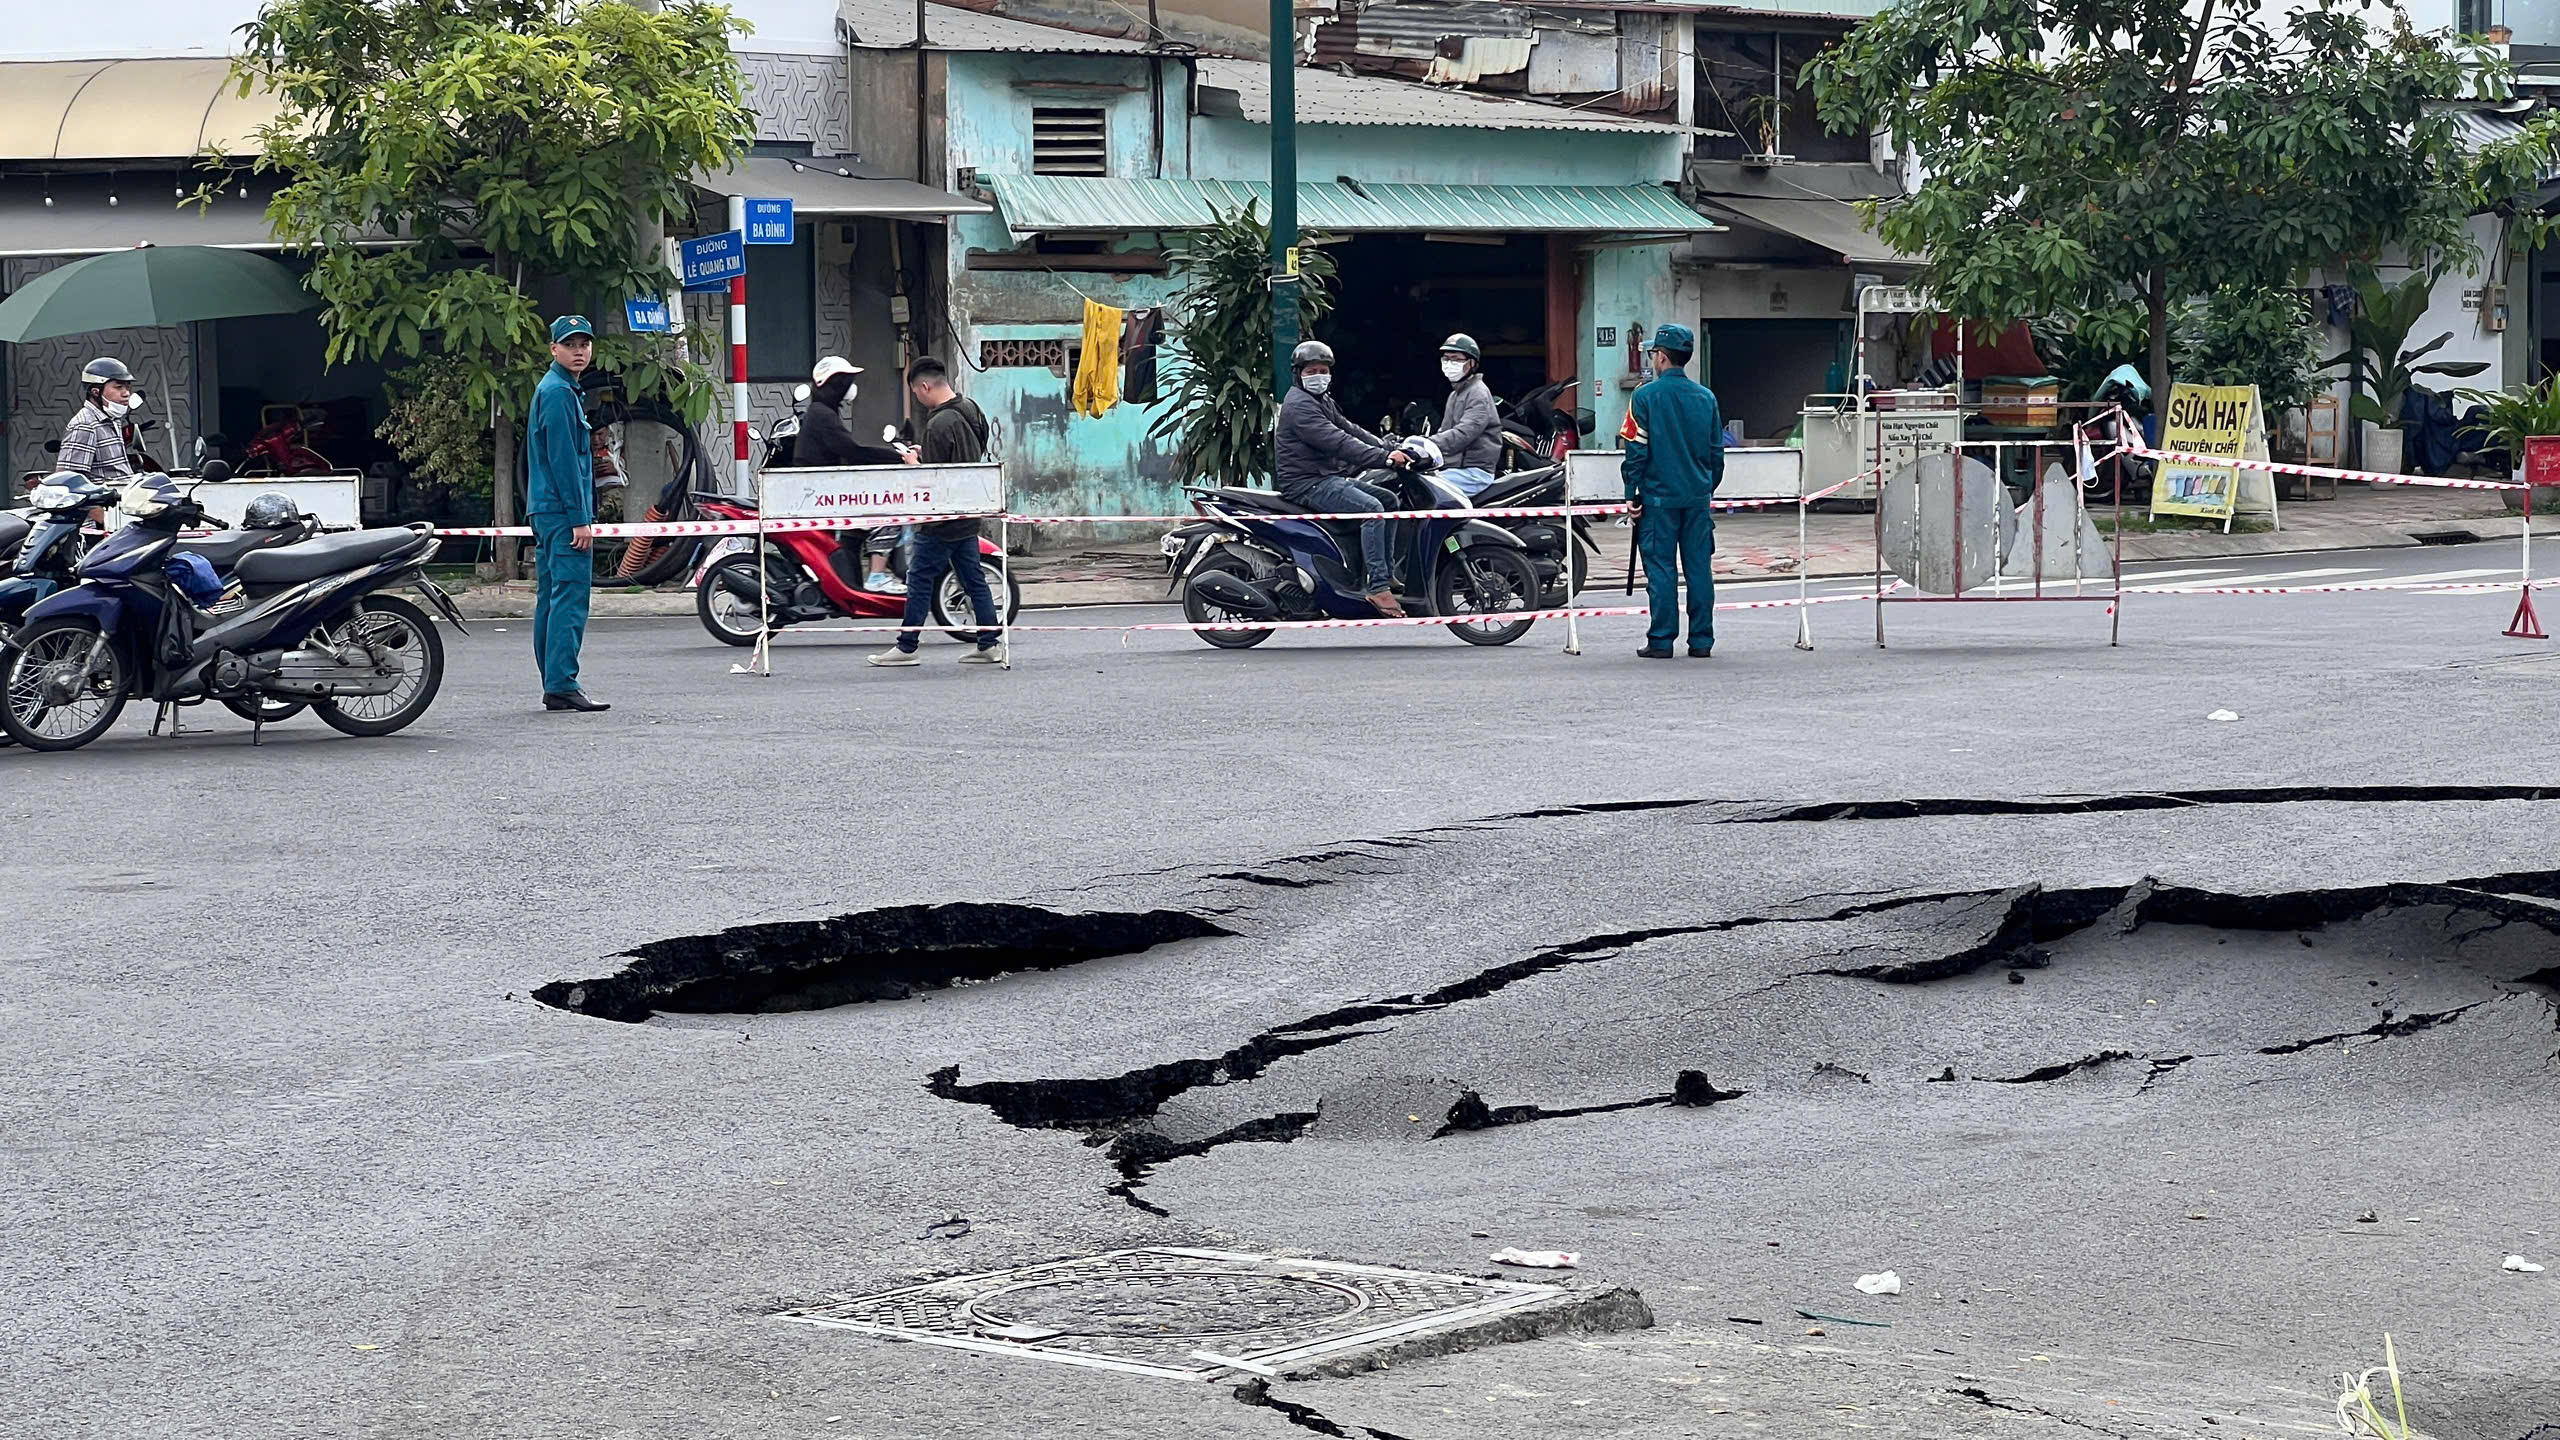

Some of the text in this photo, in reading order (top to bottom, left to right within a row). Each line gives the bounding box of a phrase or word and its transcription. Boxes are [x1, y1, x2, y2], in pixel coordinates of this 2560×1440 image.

[757, 203, 781, 214] ĐƯỜNG
[753, 220, 785, 238] BA ĐÌNH
[696, 239, 728, 255] ĐƯỜNG
[687, 255, 741, 278] LÊ QUANG KIM
[634, 310, 647, 324] BA
[2169, 392, 2248, 437] SỮA HẠT
[1912, 433, 1921, 441] Ti
[2169, 439, 2213, 454] NGUYÊN
[2215, 438, 2238, 455] CHẤT
[814, 494, 834, 507] XN
[839, 490, 869, 506] PHÚ
[873, 489, 904, 505] LÂM
